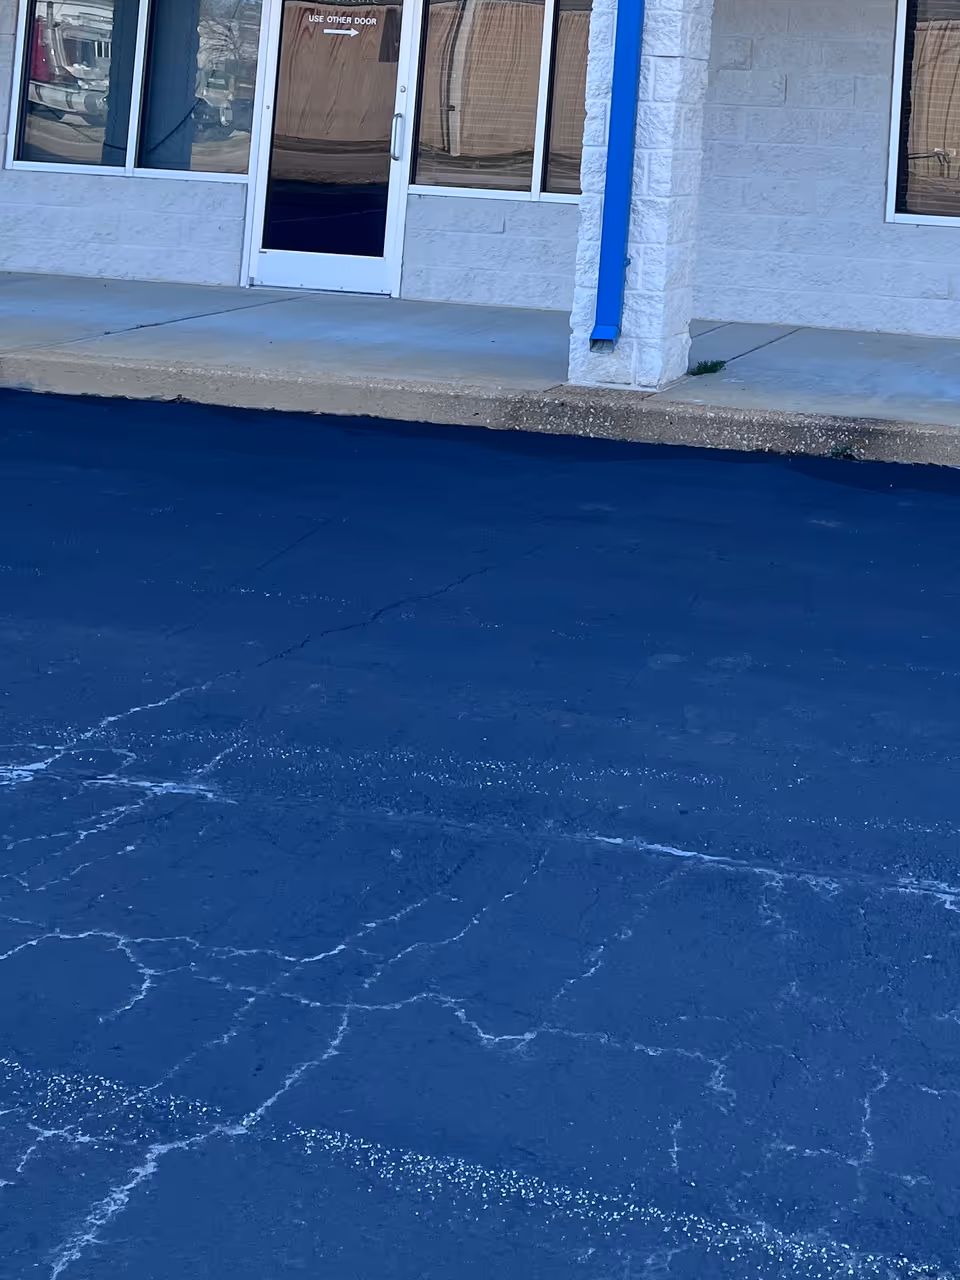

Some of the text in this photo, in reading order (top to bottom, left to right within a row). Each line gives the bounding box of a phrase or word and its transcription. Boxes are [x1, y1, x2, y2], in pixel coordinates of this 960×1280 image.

[308, 15, 377, 25] USE OTHER DOOR
